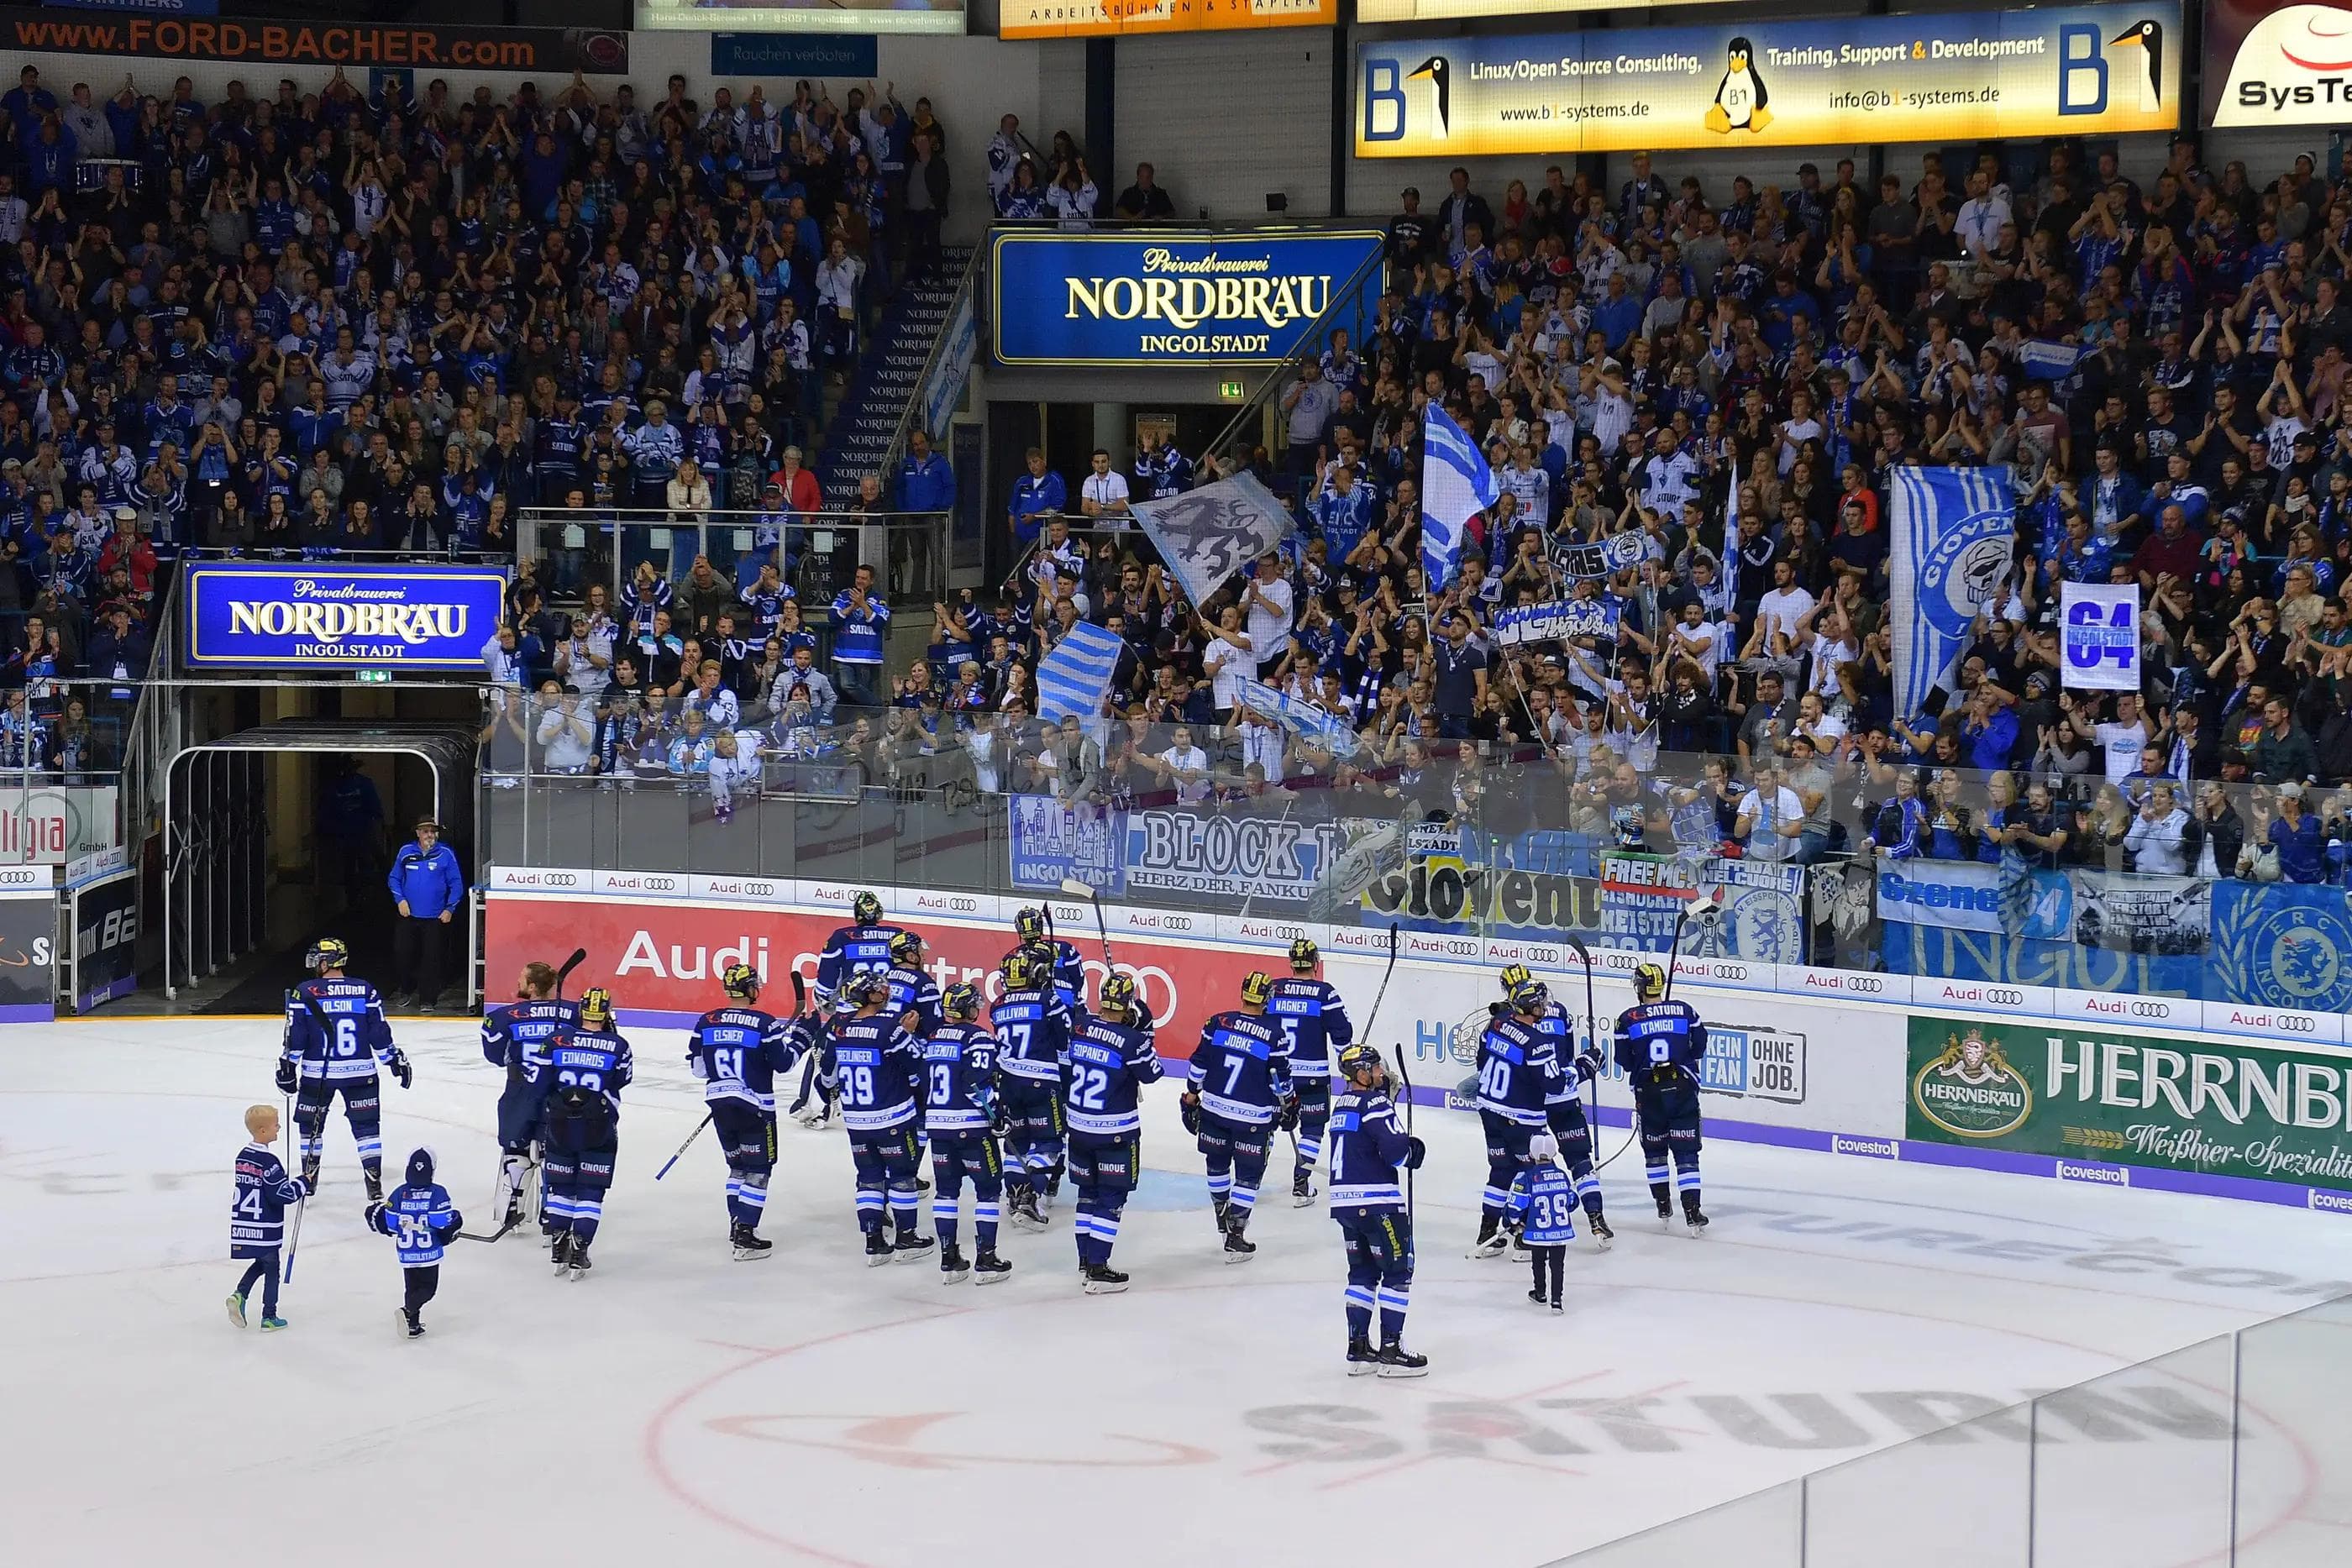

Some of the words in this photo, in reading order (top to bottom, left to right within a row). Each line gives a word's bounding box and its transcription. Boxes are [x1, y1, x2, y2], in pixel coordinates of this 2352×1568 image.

[1030, 3, 1191, 20] ARBEITSBÜHNEN
[1206, 2, 1215, 11] &
[14, 19, 535, 67] www.FORD-BACHER.com
[733, 45, 791, 62] Rauchen
[794, 47, 856, 63] verboten
[1767, 47, 1838, 69] Training,
[1840, 43, 1907, 67] Support
[1912, 40, 1927, 60] &
[1931, 36, 2046, 60] Development
[1470, 60, 1557, 81] Linux/Open
[1561, 57, 1613, 76] Source
[1615, 52, 1703, 75] Consulting,
[1829, 86, 2000, 111] info@b1-systems.de
[1500, 102, 1650, 123] www.b1-systems.de
[1142, 247, 1271, 273] Privatbrauerei
[1064, 275, 1331, 328] NORDBRÄU
[1141, 334, 1270, 353] INGOLSTADT
[292, 579, 407, 600] Privatbrauerei
[228, 600, 470, 645] NORDBRÄU
[295, 644, 406, 658] INGOLSTADT
[80, 842, 108, 852] GmbH
[1143, 810, 1301, 881] BLOCK
[505, 873, 540, 884] Audi
[1019, 862, 1117, 888] INGOLSTADT
[1604, 857, 1656, 886] FREE
[1702, 869, 1734, 884] NEL
[606, 876, 641, 889] Audi
[709, 882, 742, 894] Audi
[1132, 872, 1188, 891] HERZ
[1191, 878, 1235, 894] DER
[814, 888, 845, 900] Audi
[917, 895, 947, 909] Audi
[1129, 914, 1160, 927] Audi
[1240, 923, 1273, 937] Audi
[1335, 932, 1368, 946] Audi
[1410, 938, 1443, 953] Audi
[858, 945, 886, 957] REIMER
[1488, 944, 1523, 959] Audi
[1673, 961, 1710, 977] Audi
[327, 984, 365, 995] SATURN
[1806, 973, 1843, 989] Audi
[1004, 992, 1042, 1004] SATURN
[1284, 983, 1320, 997] SATURN
[1942, 986, 1982, 1001] Audi
[322, 999, 352, 1013] OLSON
[1275, 999, 1308, 1014] WAGNER
[1646, 1004, 1684, 1018] SATURN
[2086, 999, 2127, 1014] Audi
[721, 1012, 760, 1028] SATURN
[1641, 1019, 1674, 1036] D'AMIGO
[2230, 1011, 2271, 1027] Audi
[713, 1029, 744, 1044] ELSNER
[845, 1026, 879, 1040] SATURN
[935, 1027, 966, 1041] SATURN
[1085, 1025, 1126, 1049] SATURN
[1233, 1019, 1272, 1041] SATURN
[1499, 1022, 1530, 1045] SATURN
[573, 1036, 617, 1051] SATURN
[1224, 1032, 1254, 1051] JOBKE
[1705, 1034, 1741, 1059] KEIN
[561, 1051, 606, 1068] EDWARDS
[1073, 1043, 1110, 1063] SOPANEN
[1751, 1038, 1795, 1064] OHNE
[972, 1051, 990, 1069] 33
[1223, 1054, 1245, 1095] 7
[1544, 1059, 1560, 1079] 40
[1705, 1062, 1742, 1088] FAN
[838, 1066, 875, 1105] 39
[1068, 1064, 1109, 1109] 22
[1478, 1056, 1511, 1100] 40
[1751, 1063, 1798, 1093] JOB.
[2046, 1037, 2352, 1132] HERRNB
[349, 1096, 378, 1109] CINQUE
[1924, 1083, 2021, 1108] HERRNBRÄU
[1200, 1132, 1226, 1146] CINQUE
[1557, 1130, 1586, 1140] CINQUE
[1669, 1128, 1696, 1138] CINQUE
[1234, 1140, 1262, 1155] CINQUE
[1837, 1138, 1892, 1156] covestro
[580, 1162, 611, 1174] CINQUE
[1098, 1162, 1126, 1172] CINQUE
[2062, 1162, 2122, 1183] covestro
[1534, 1193, 1569, 1229] 39
[232, 1227, 264, 1240] SATURN
[1240, 1386, 2255, 1462] SATURN
